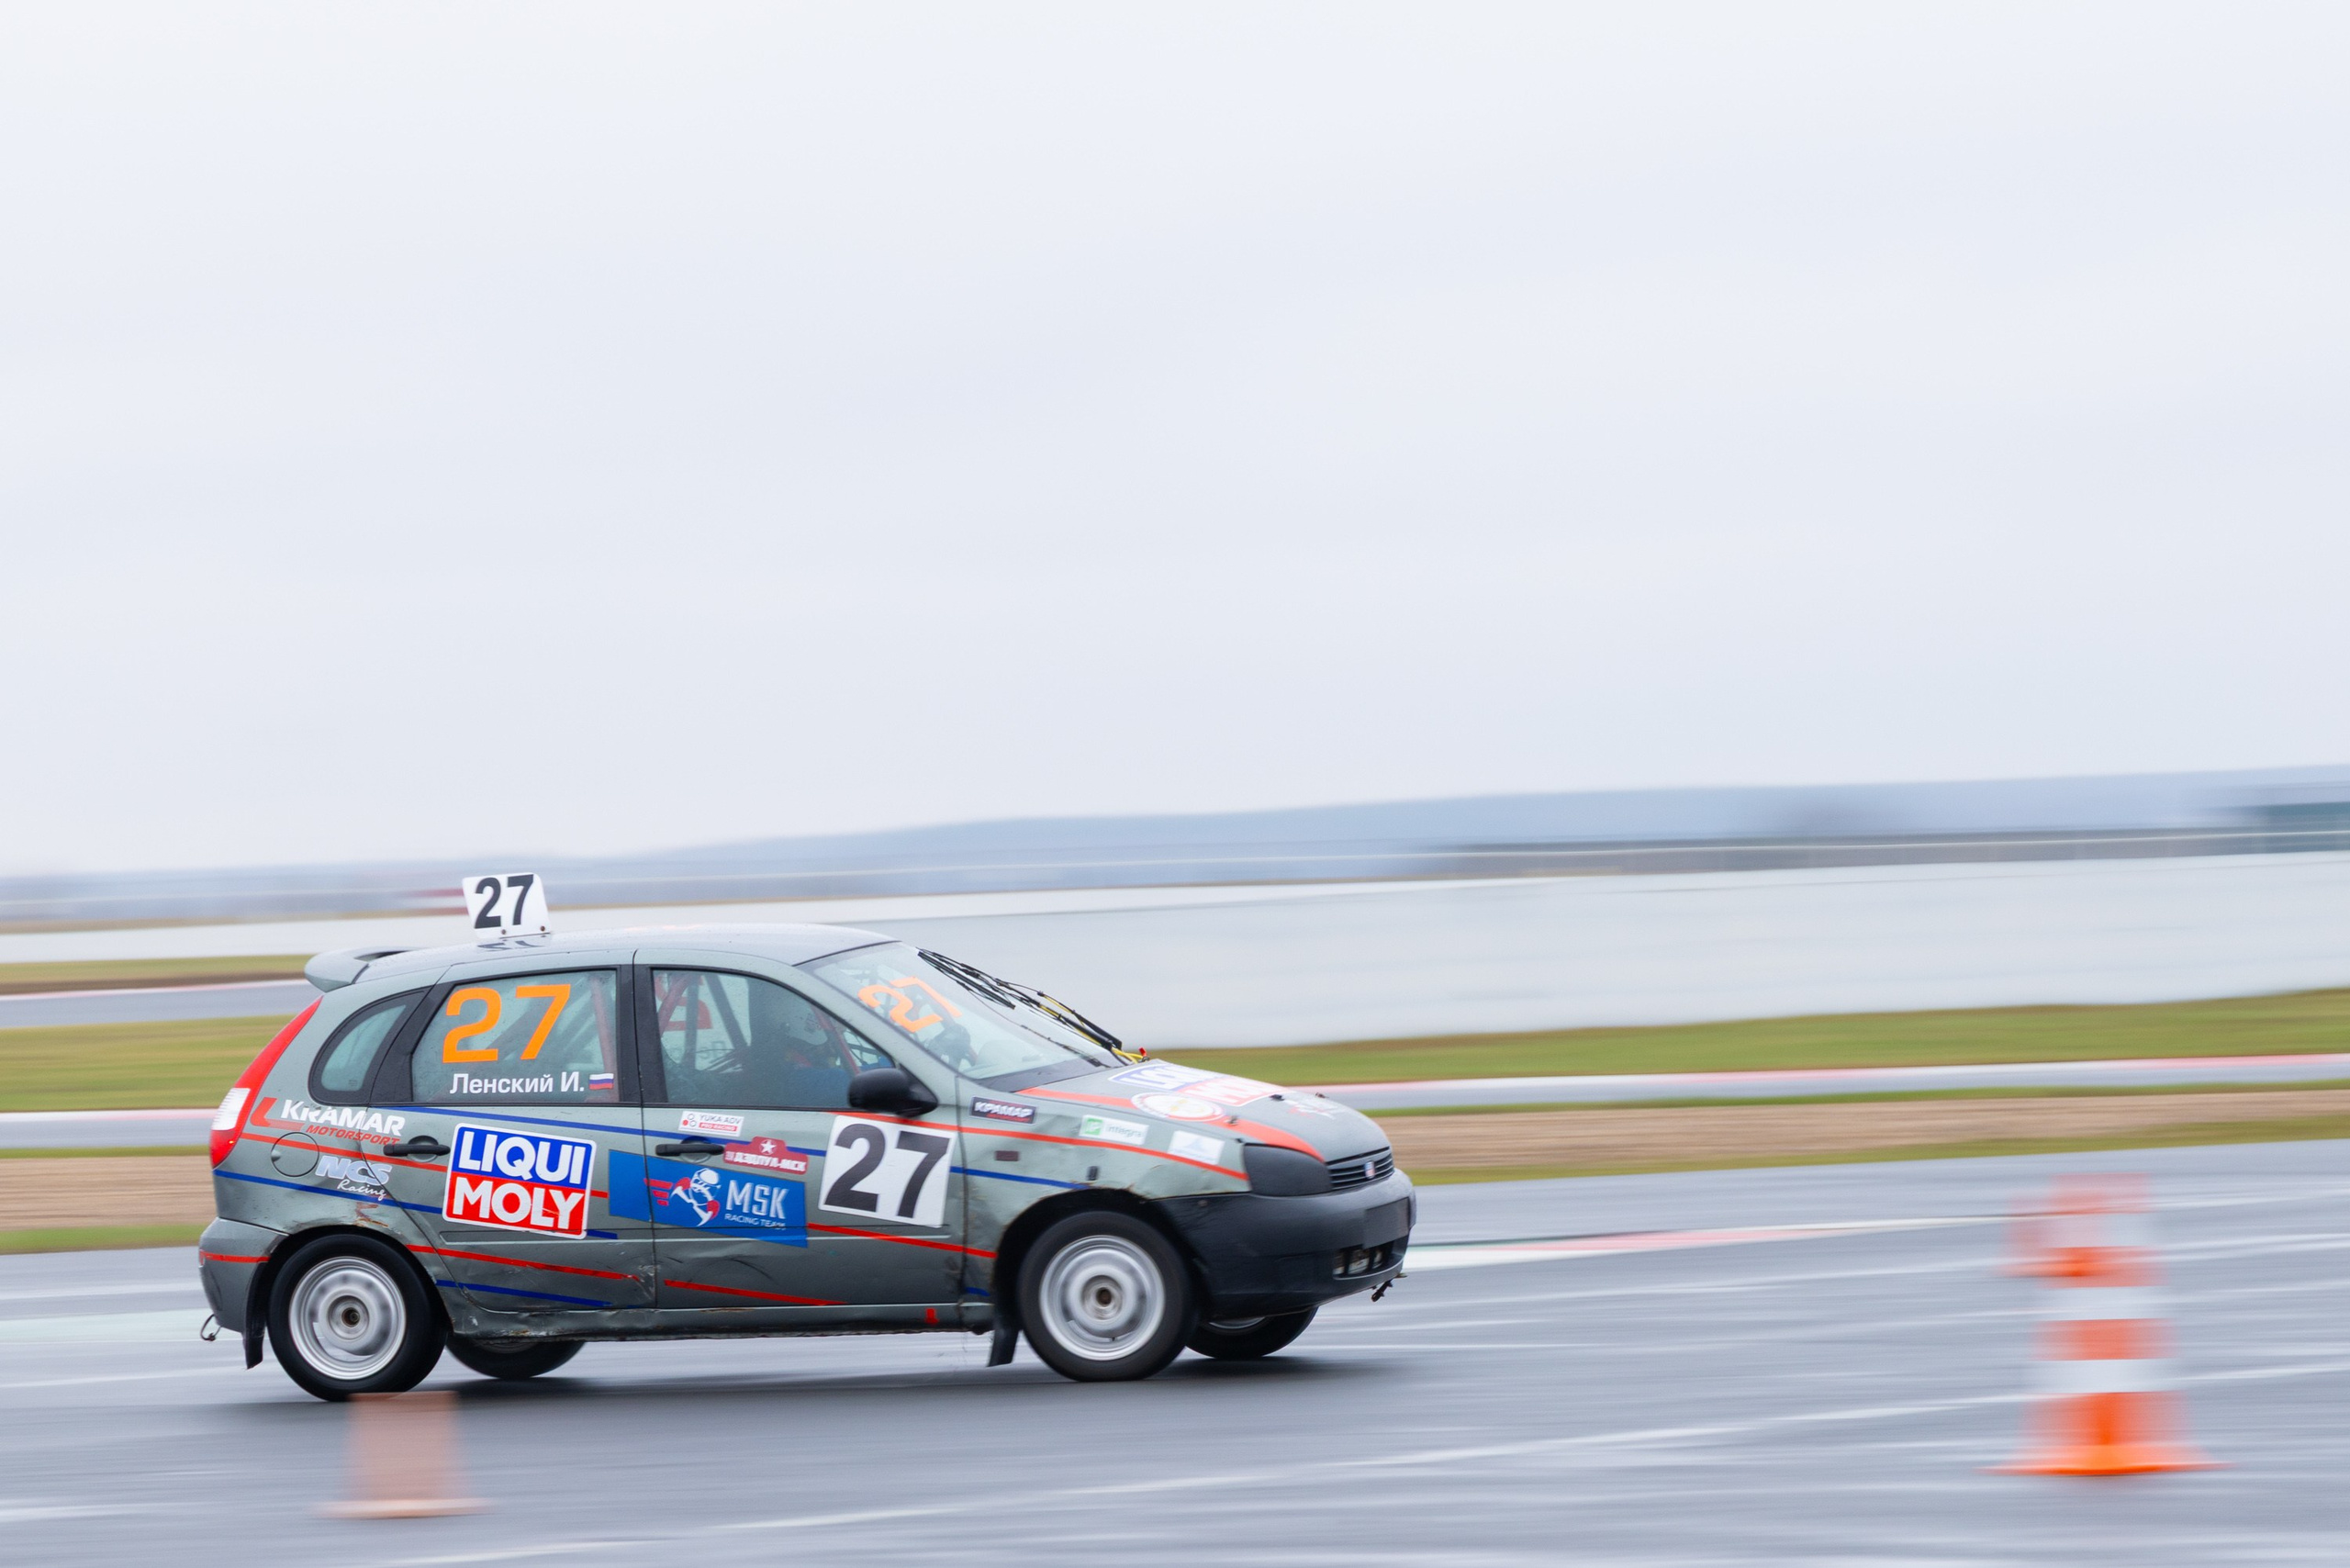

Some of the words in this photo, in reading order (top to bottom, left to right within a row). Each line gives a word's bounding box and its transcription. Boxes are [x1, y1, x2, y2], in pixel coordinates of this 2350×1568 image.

[474, 874, 534, 929] 27
[442, 984, 571, 1063] 27
[857, 976, 963, 1033] 27
[450, 1073, 553, 1094] Ленский
[561, 1071, 585, 1092] И.
[280, 1099, 406, 1137] KRAMAR
[306, 1125, 401, 1146] MOTORSPORT
[315, 1155, 392, 1186] NCS
[458, 1131, 586, 1184] LIQUI
[824, 1124, 950, 1218] 27
[337, 1179, 386, 1201] Racing
[453, 1176, 584, 1229] MOLY
[725, 1180, 789, 1219] MSK
[724, 1214, 758, 1226] RACING
